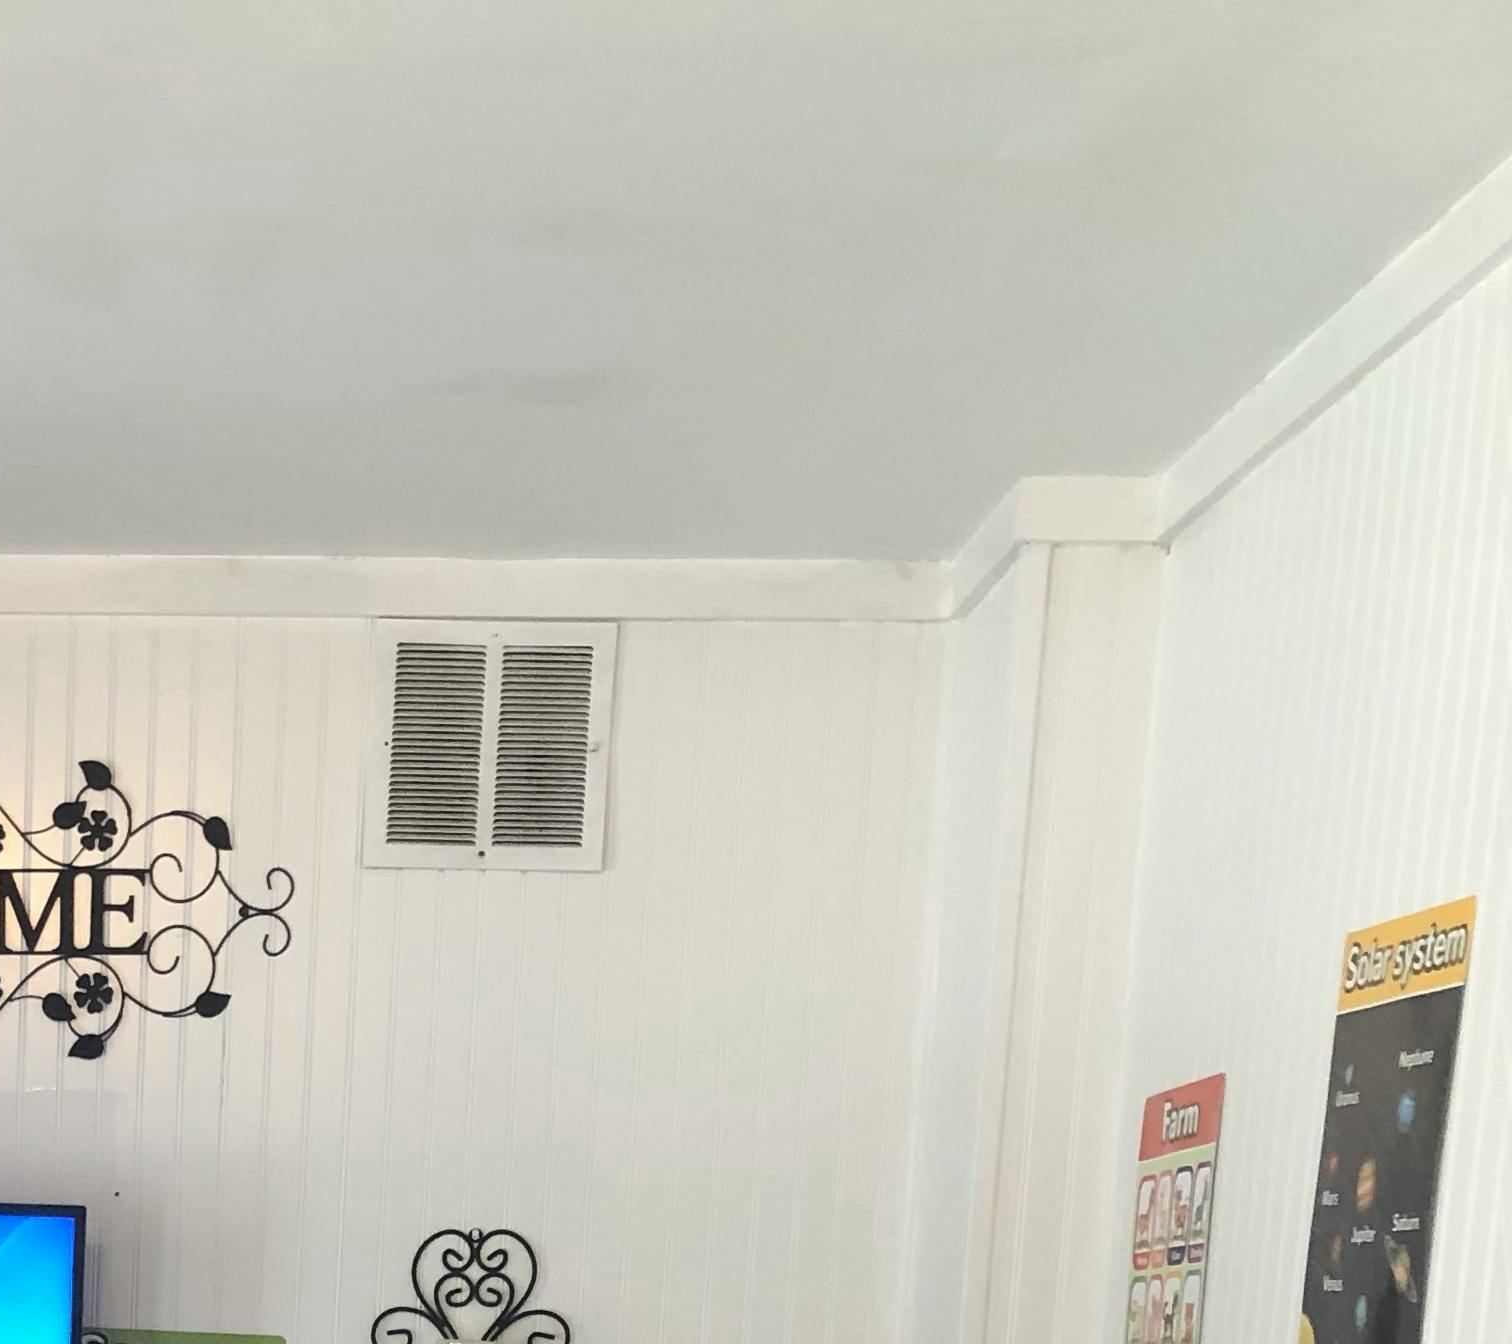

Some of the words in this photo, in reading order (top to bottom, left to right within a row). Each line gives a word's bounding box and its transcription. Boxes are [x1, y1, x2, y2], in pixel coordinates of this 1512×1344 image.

[1345, 939, 1393, 993] Solar
[1392, 922, 1467, 990] system
[1161, 1101, 1200, 1142] Farm
